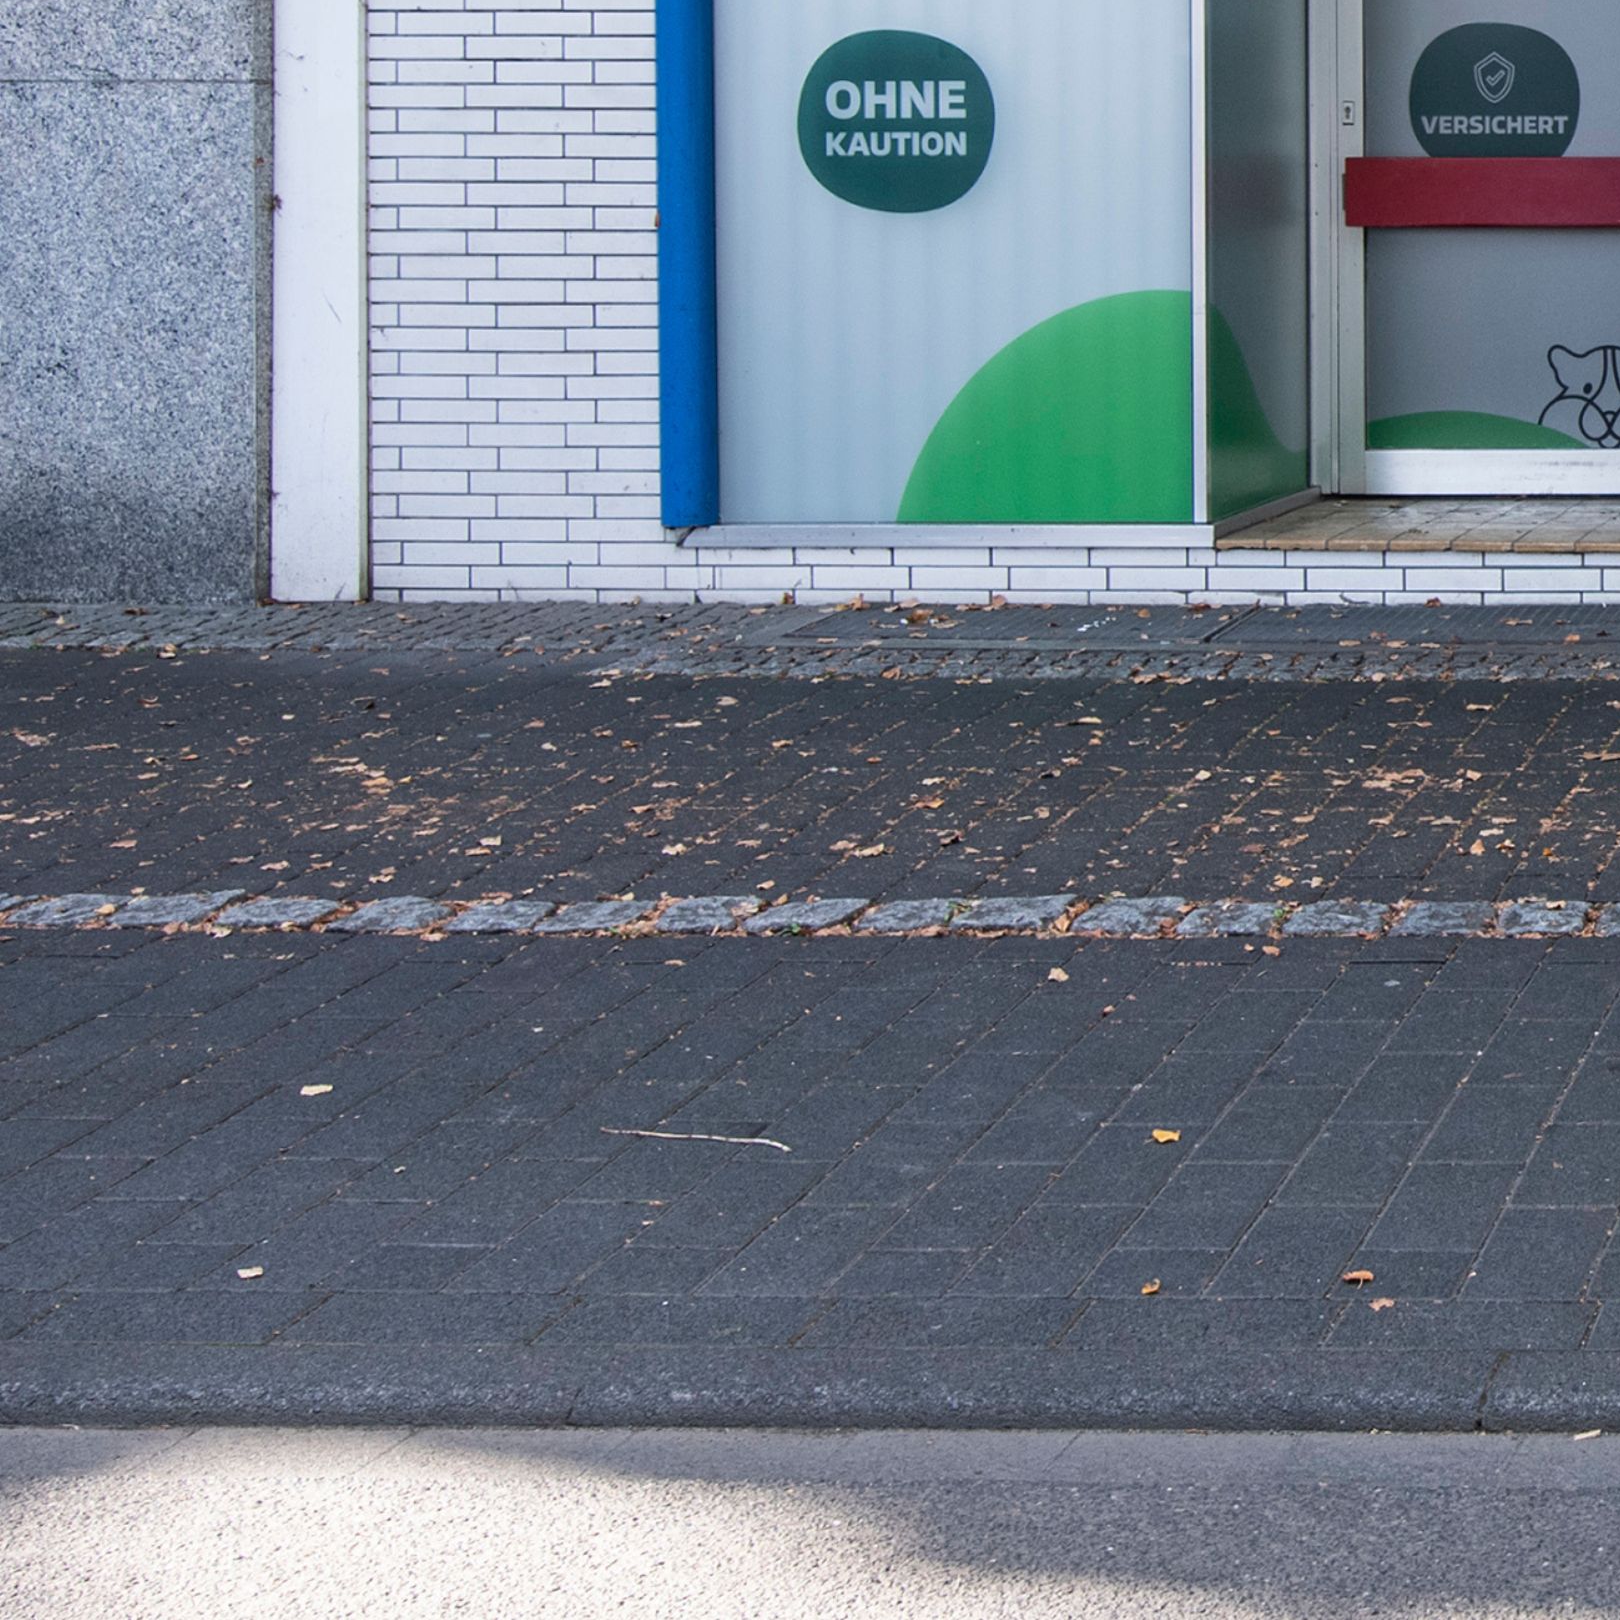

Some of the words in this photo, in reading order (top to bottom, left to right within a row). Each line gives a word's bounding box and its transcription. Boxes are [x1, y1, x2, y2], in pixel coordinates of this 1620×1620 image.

[825, 80, 967, 120] OHNE
[1421, 115, 1569, 134] VERSICHERT
[825, 131, 967, 157] KAUTION
